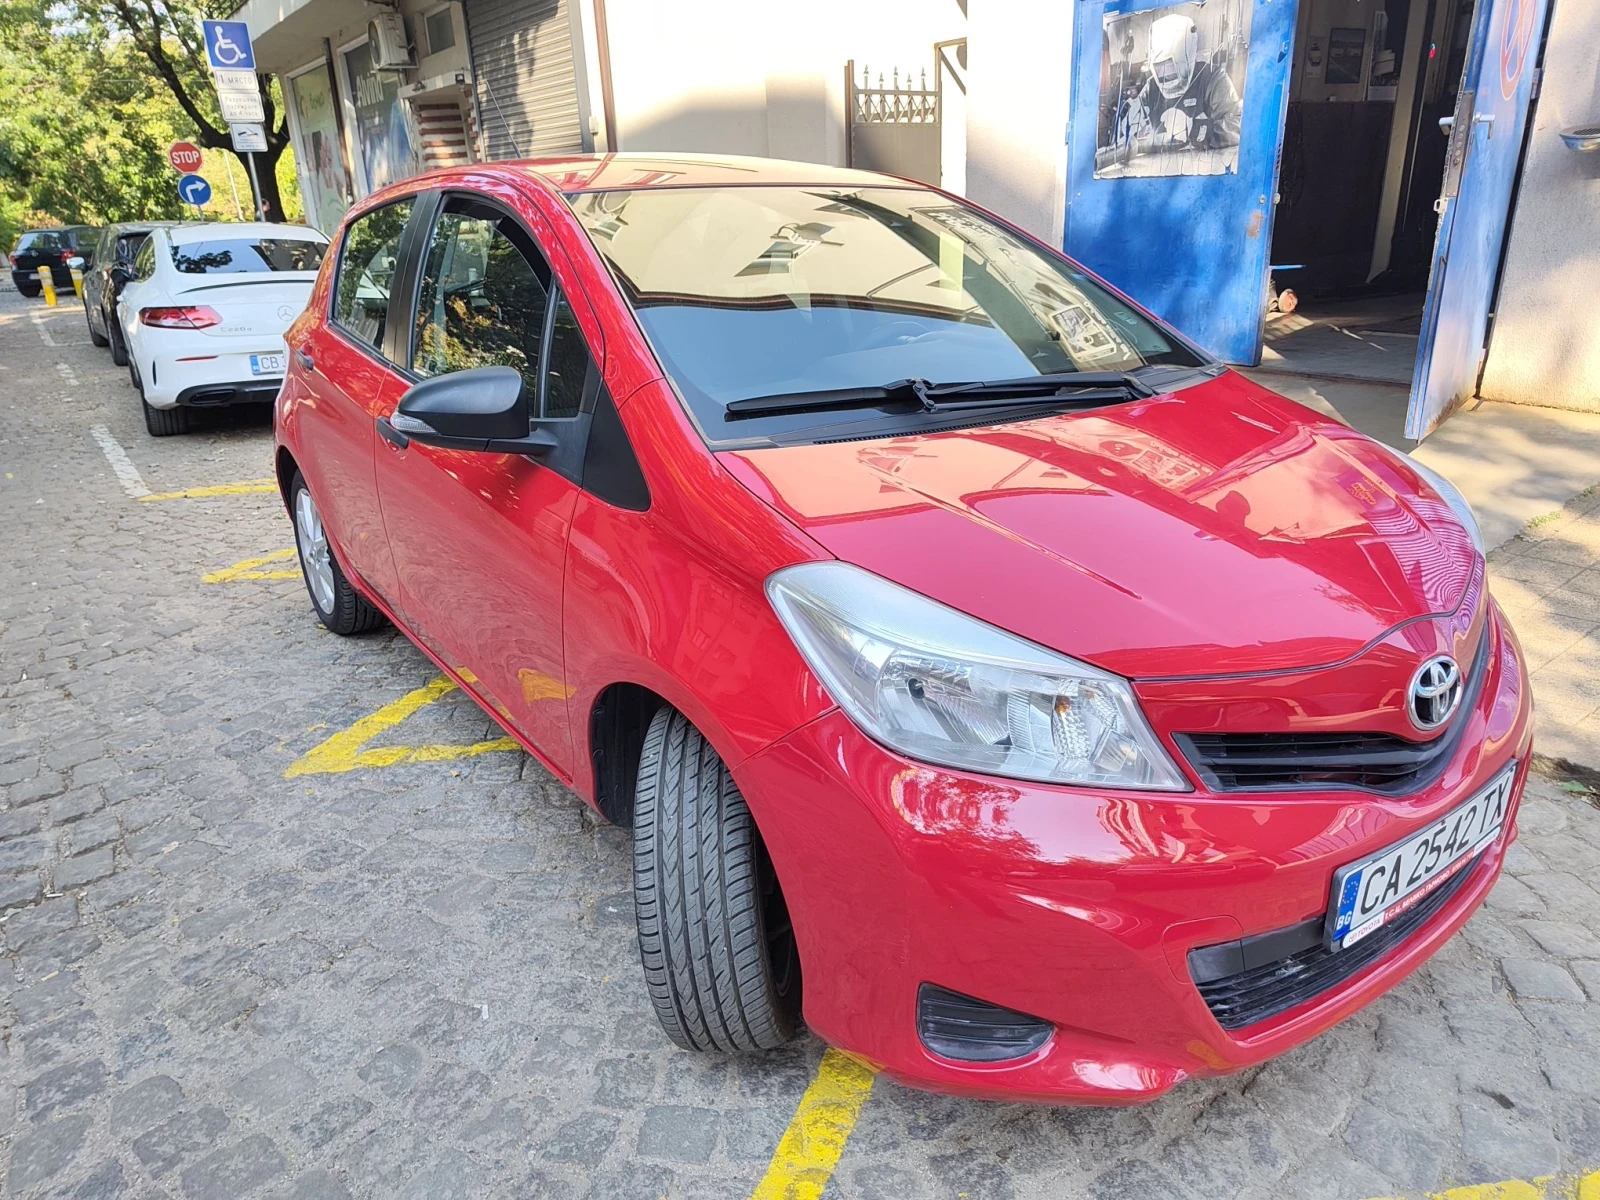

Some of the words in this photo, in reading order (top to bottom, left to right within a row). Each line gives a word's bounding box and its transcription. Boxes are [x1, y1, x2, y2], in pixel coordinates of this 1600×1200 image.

[228, 76, 253, 84] МЯСТО
[172, 151, 199, 164] STOP
[1361, 854, 1402, 915] CA
[1406, 805, 1478, 888] 2542
[1479, 776, 1510, 834] TX
[1336, 911, 1352, 931] BG
[1357, 918, 1381, 937] TOYOTA
